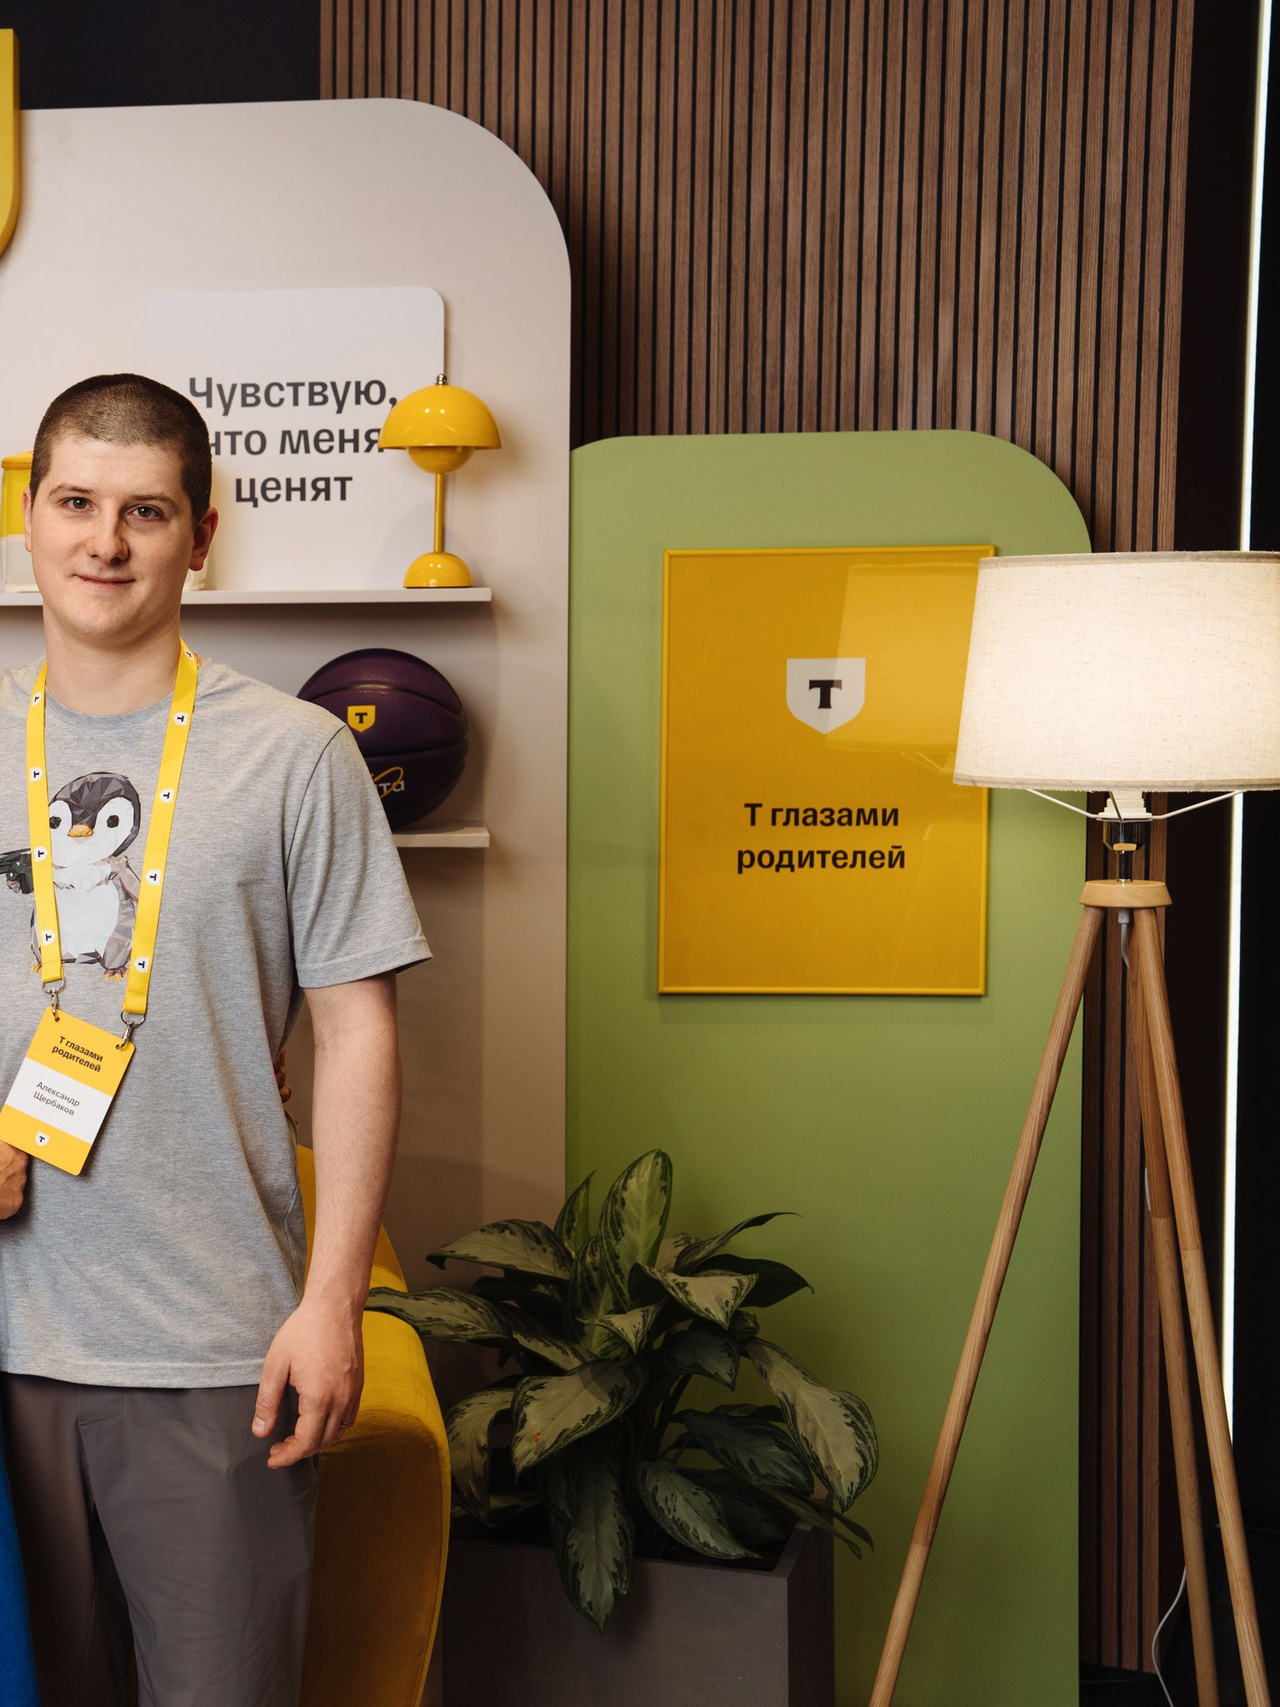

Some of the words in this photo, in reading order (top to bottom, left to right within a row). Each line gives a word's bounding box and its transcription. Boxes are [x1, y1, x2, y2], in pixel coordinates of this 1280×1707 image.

[188, 376, 397, 417] Чувствую,
[278, 427, 384, 455] меня
[235, 475, 354, 508] ценят
[808, 679, 843, 709] Т
[354, 712, 368, 724] Т
[744, 803, 763, 827] Т
[770, 807, 899, 827] глазами
[736, 845, 906, 875] родителей
[51, 1045, 102, 1073] родителей
[65, 1039, 104, 1062] глазами
[33, 1090, 75, 1116] Щербаков
[36, 1081, 80, 1107] Александр
